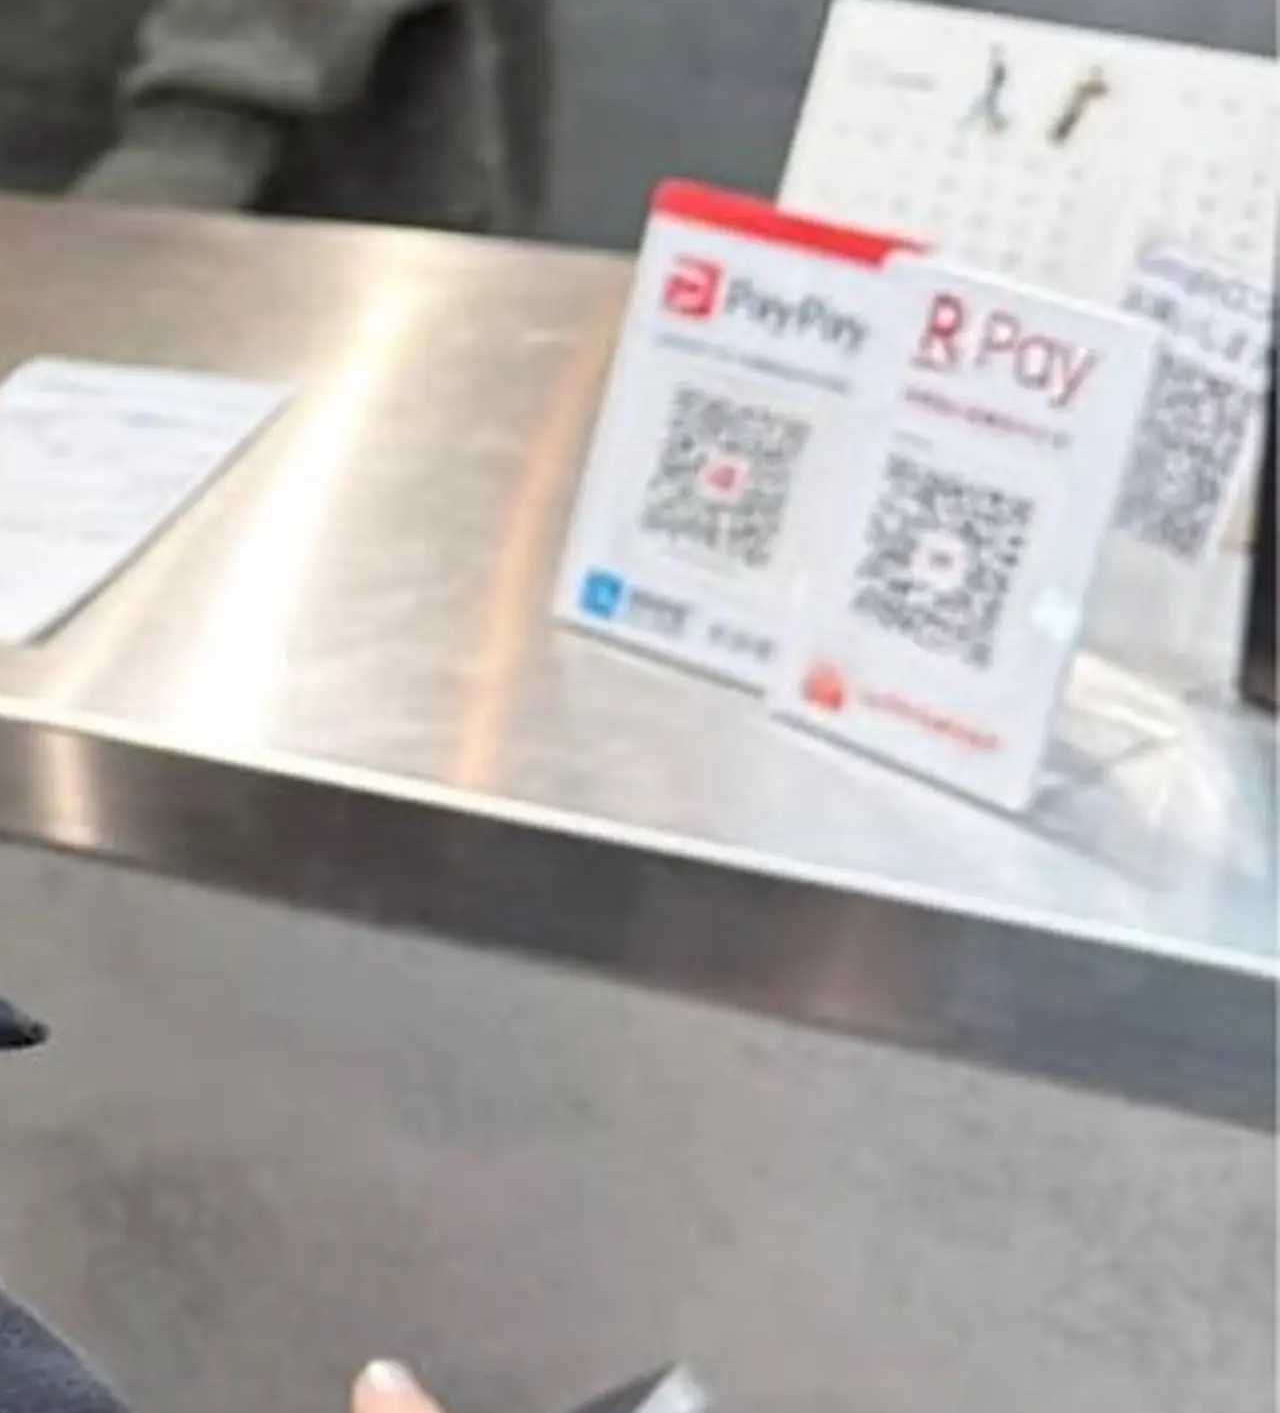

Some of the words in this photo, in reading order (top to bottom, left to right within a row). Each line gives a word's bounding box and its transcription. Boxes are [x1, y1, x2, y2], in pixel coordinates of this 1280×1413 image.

[724, 277, 867, 354] PayPay
[911, 291, 965, 369] R
[975, 309, 1098, 409] Pay
